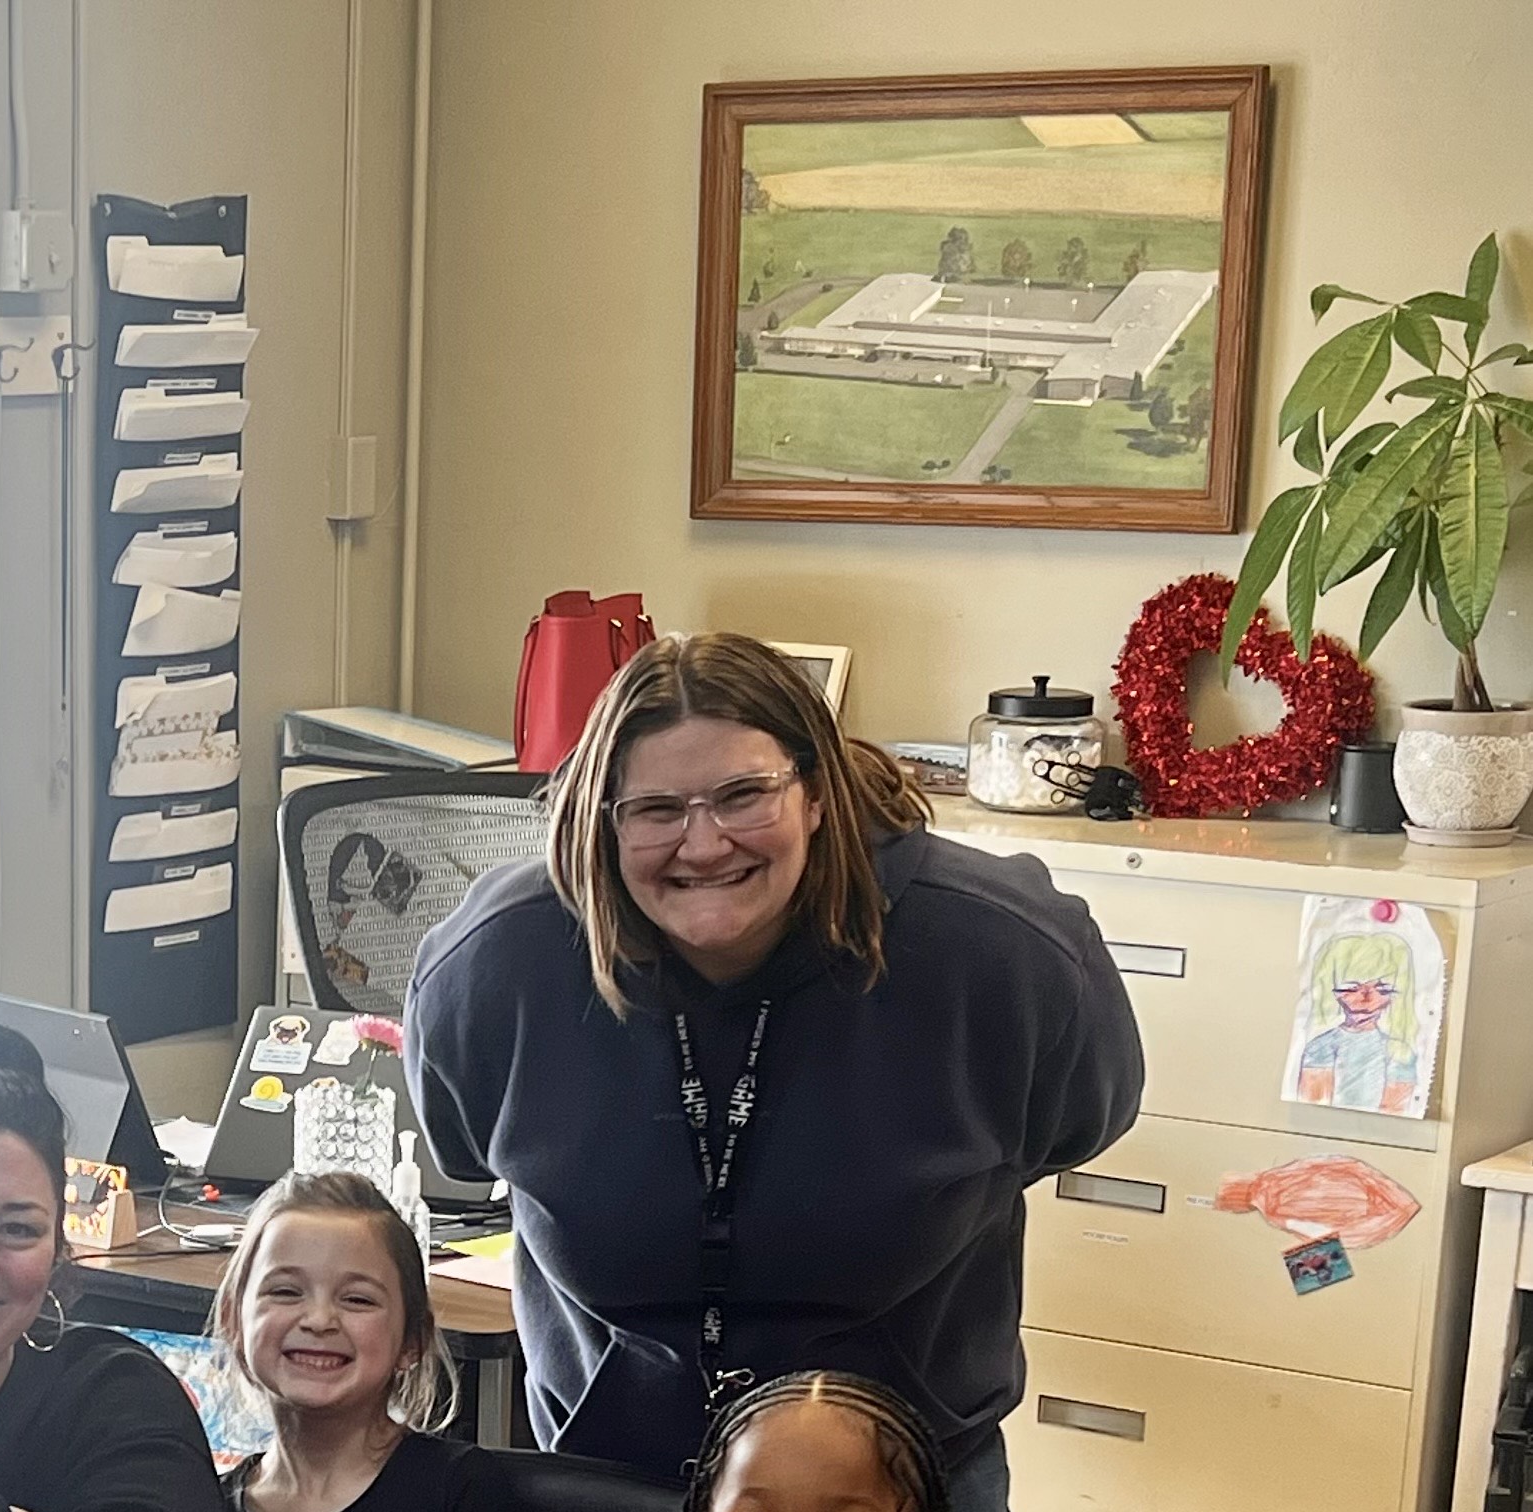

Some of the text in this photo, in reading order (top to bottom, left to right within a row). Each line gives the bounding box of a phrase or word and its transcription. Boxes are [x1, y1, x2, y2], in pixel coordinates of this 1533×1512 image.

[680, 1077, 708, 1128] GAME
[728, 1074, 756, 1127] GAME
[703, 1307, 722, 1345] GAME
